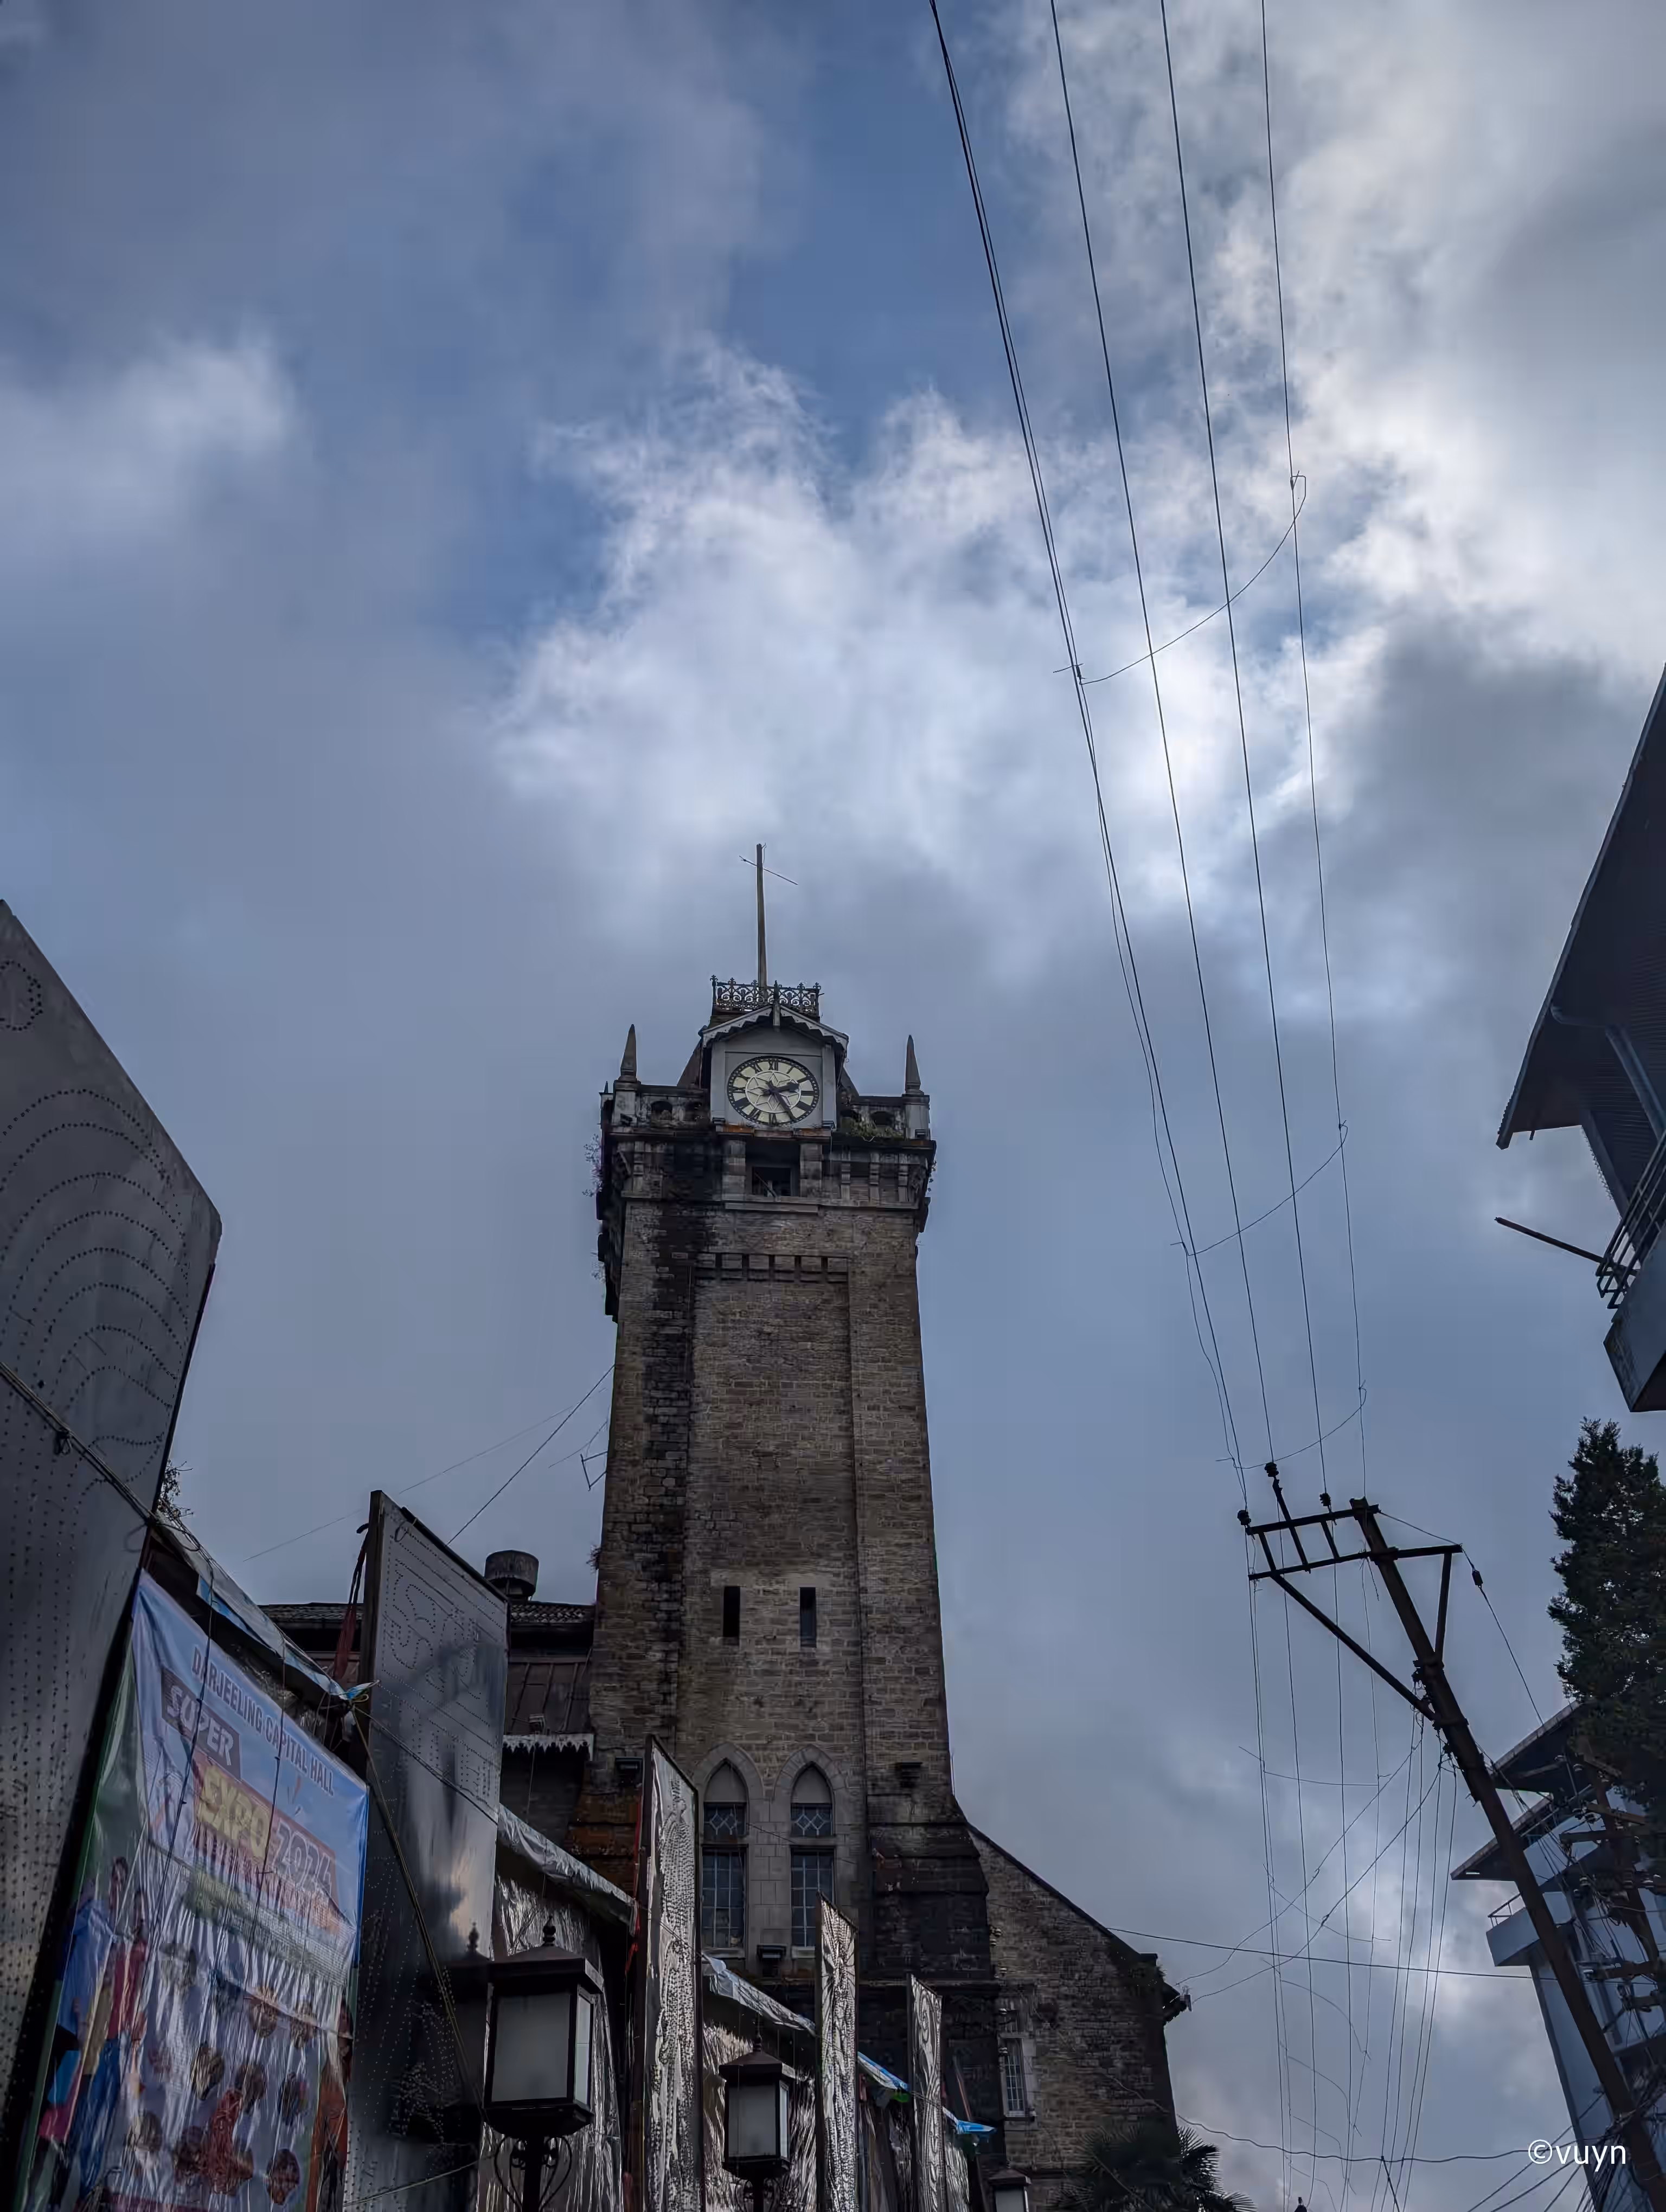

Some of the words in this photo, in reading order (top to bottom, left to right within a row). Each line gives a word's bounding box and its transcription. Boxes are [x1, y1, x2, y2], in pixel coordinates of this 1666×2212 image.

[166, 1685, 234, 1766] SUPER
[192, 1645, 262, 1735] DARJEELING
[264, 1715, 307, 1774] CAPITAL
[310, 1757, 334, 1796] HALL
[196, 1764, 270, 1860] EXPO
